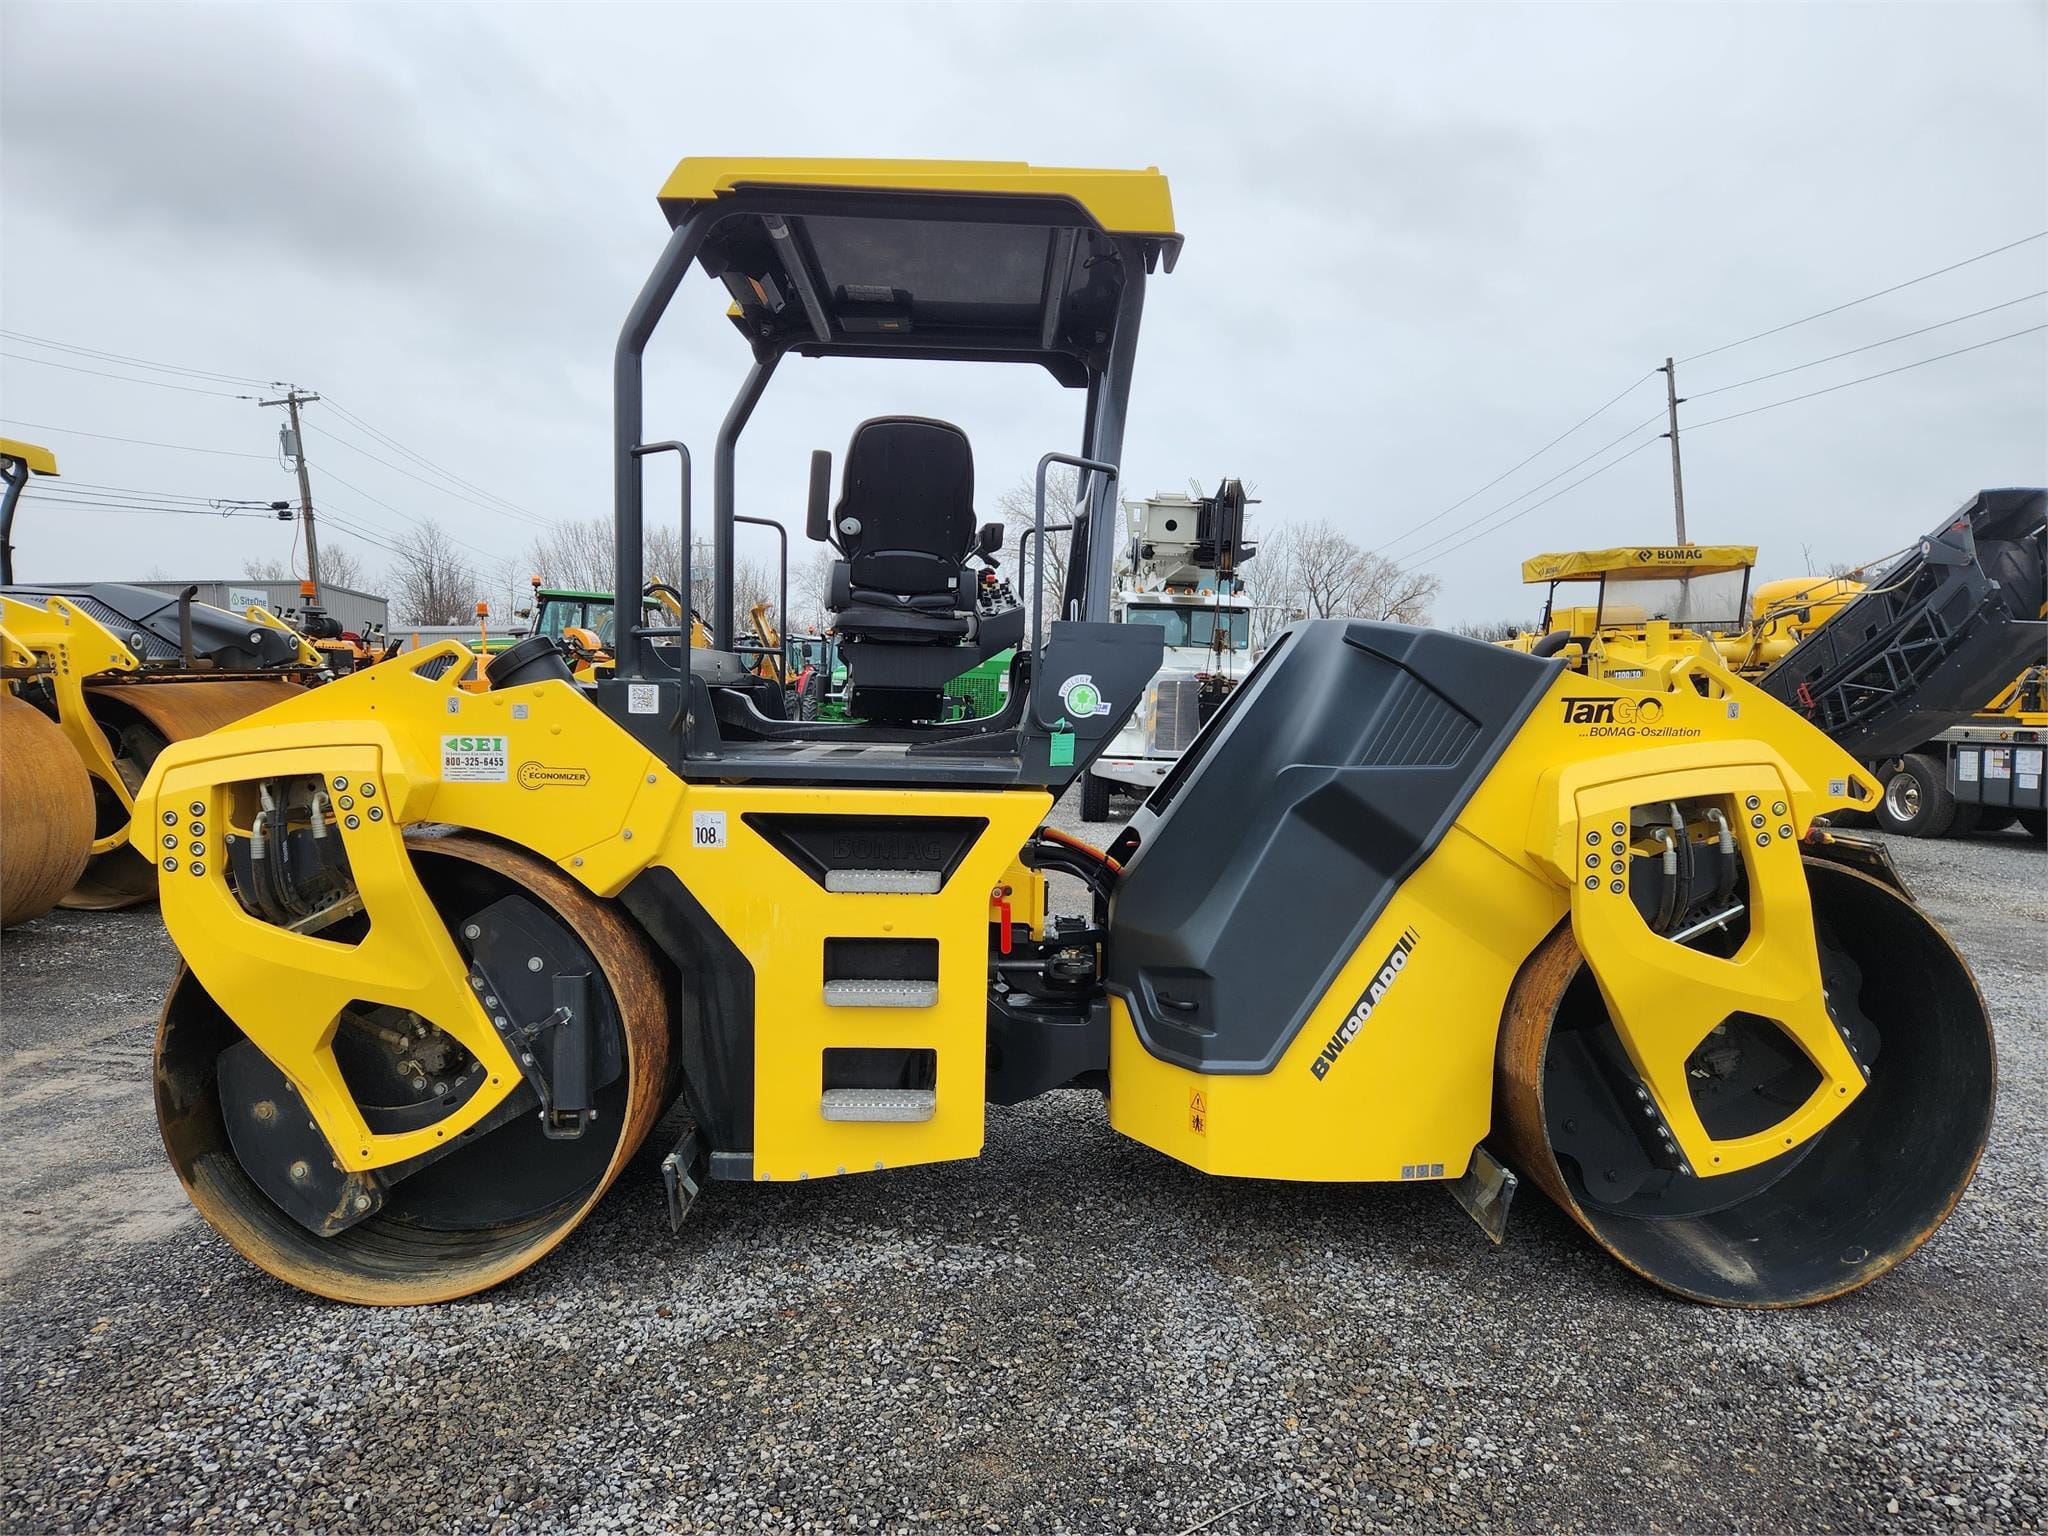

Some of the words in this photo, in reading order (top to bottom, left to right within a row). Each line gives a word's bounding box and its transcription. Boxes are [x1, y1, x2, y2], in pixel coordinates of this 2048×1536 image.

[1657, 549, 1703, 560] BOMAG
[240, 596, 267, 607] SiteOne
[1060, 676, 1090, 696] ECOLOGY
[459, 738, 503, 751] SEI
[445, 757, 504, 767] 800-325-6455
[529, 772, 586, 781] ECONOMIZER
[695, 826, 717, 844] 108
[832, 837, 943, 860] BOMAG
